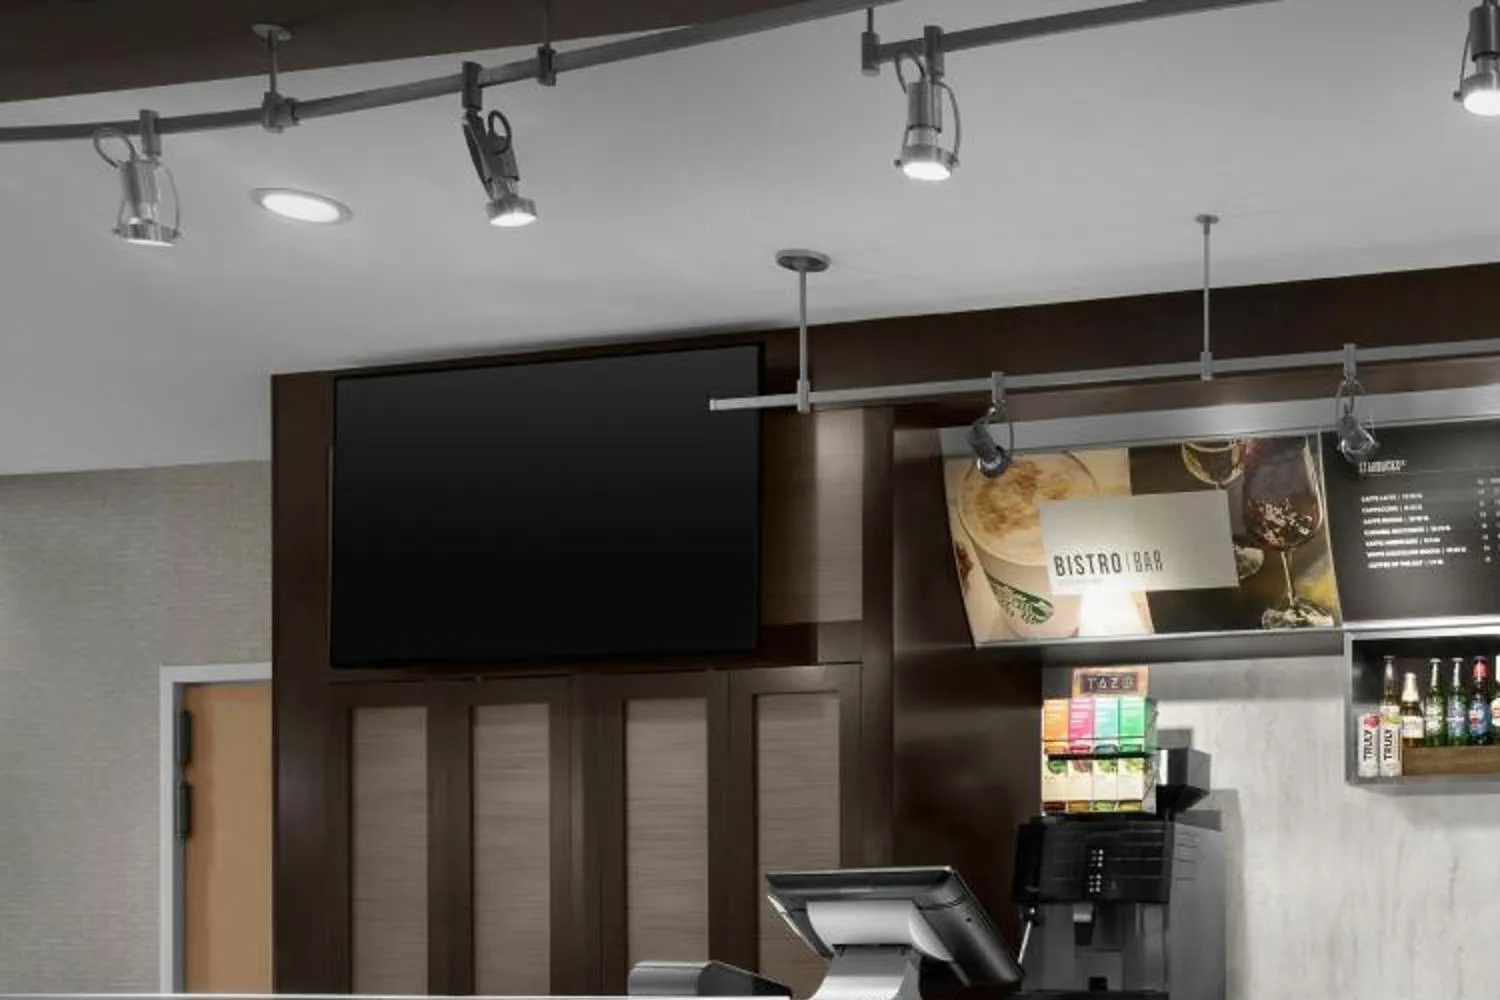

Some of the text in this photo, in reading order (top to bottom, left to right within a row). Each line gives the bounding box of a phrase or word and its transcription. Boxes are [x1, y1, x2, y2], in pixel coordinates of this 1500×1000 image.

[1054, 548, 1163, 577] BISTRO BAR
[1383, 729, 1393, 760] TRULY
